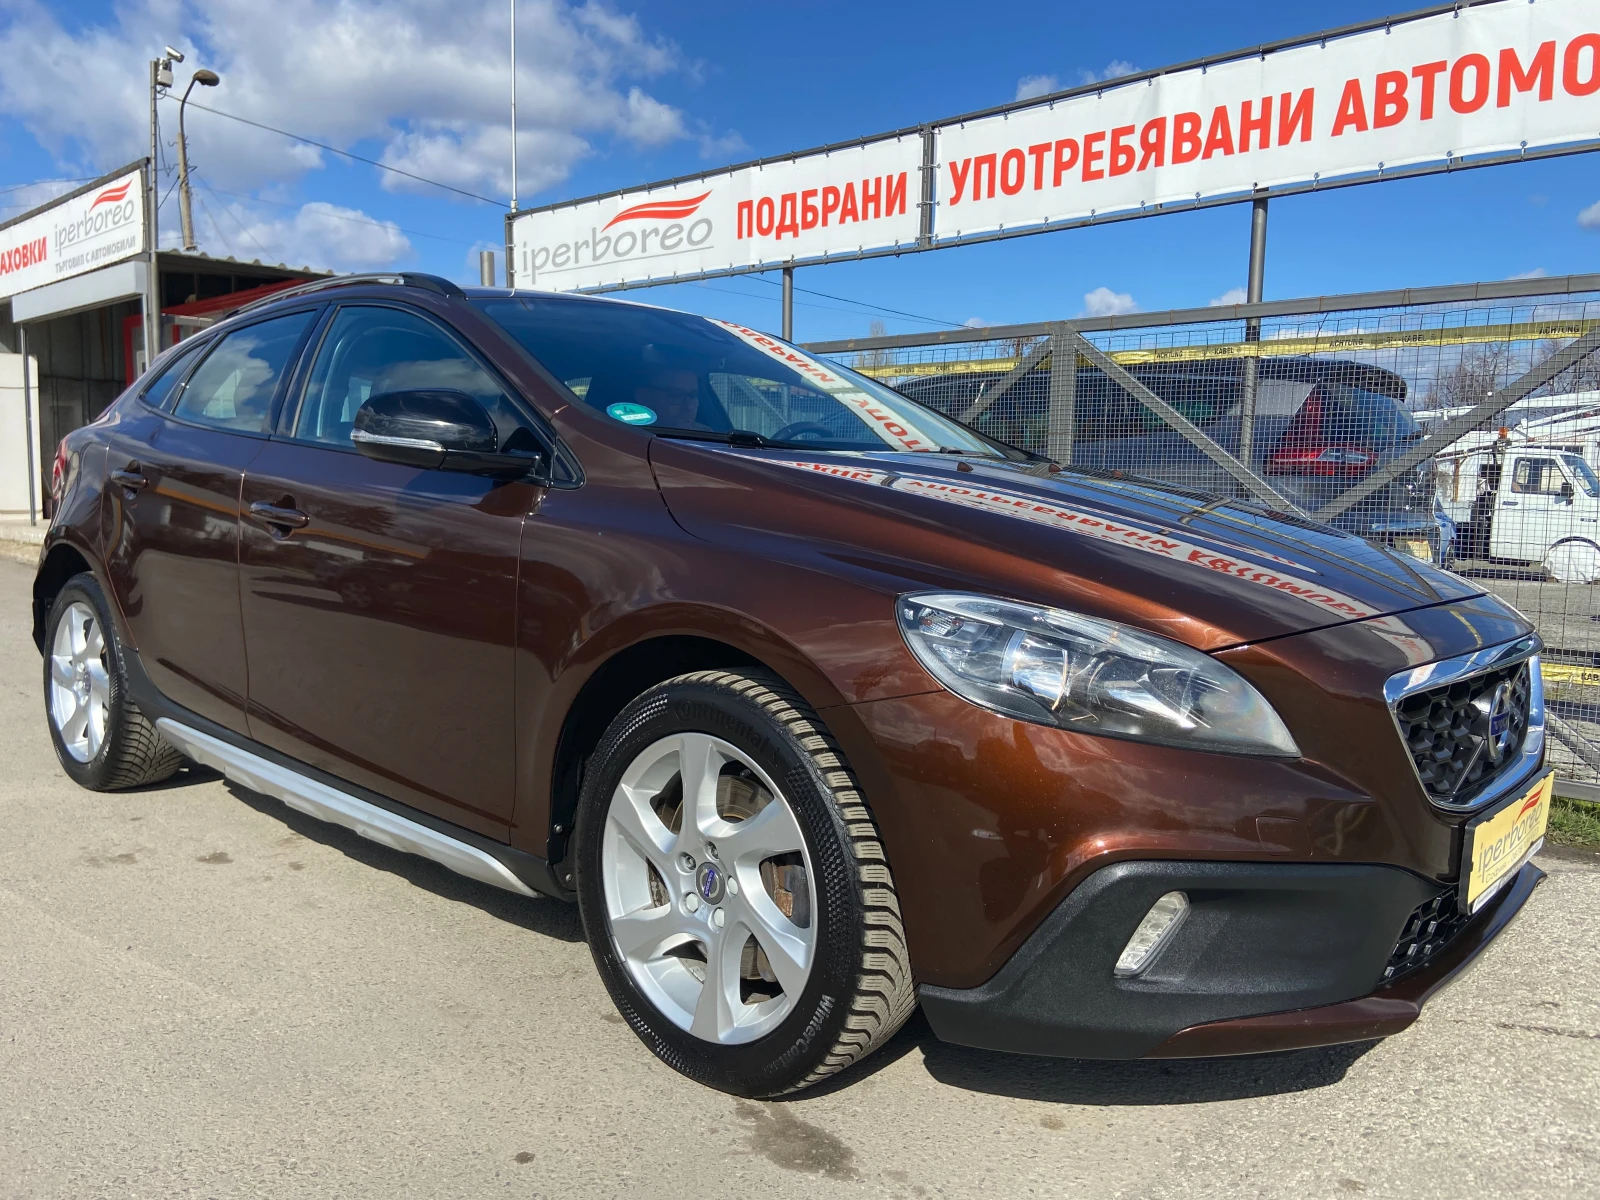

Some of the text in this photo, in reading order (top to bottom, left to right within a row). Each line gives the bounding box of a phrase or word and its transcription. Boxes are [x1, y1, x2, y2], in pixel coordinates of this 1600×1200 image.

[736, 32, 1600, 241] ПОДБРАНИ УПОТРЕБЯВАНИ АВТОМО
[54, 199, 135, 258] iperboreo
[91, 235, 136, 261] АВТОМОБИЛИ
[522, 216, 713, 286] iperboreo
[1329, 338, 1364, 348] ACHTUNG
[1401, 333, 1427, 343] KABEL
[1538, 325, 1581, 335] ACHTUNG
[1156, 350, 1183, 359] ACHTUNG
[1214, 346, 1234, 355] KABEL
[1478, 801, 1543, 884] iperboreo
